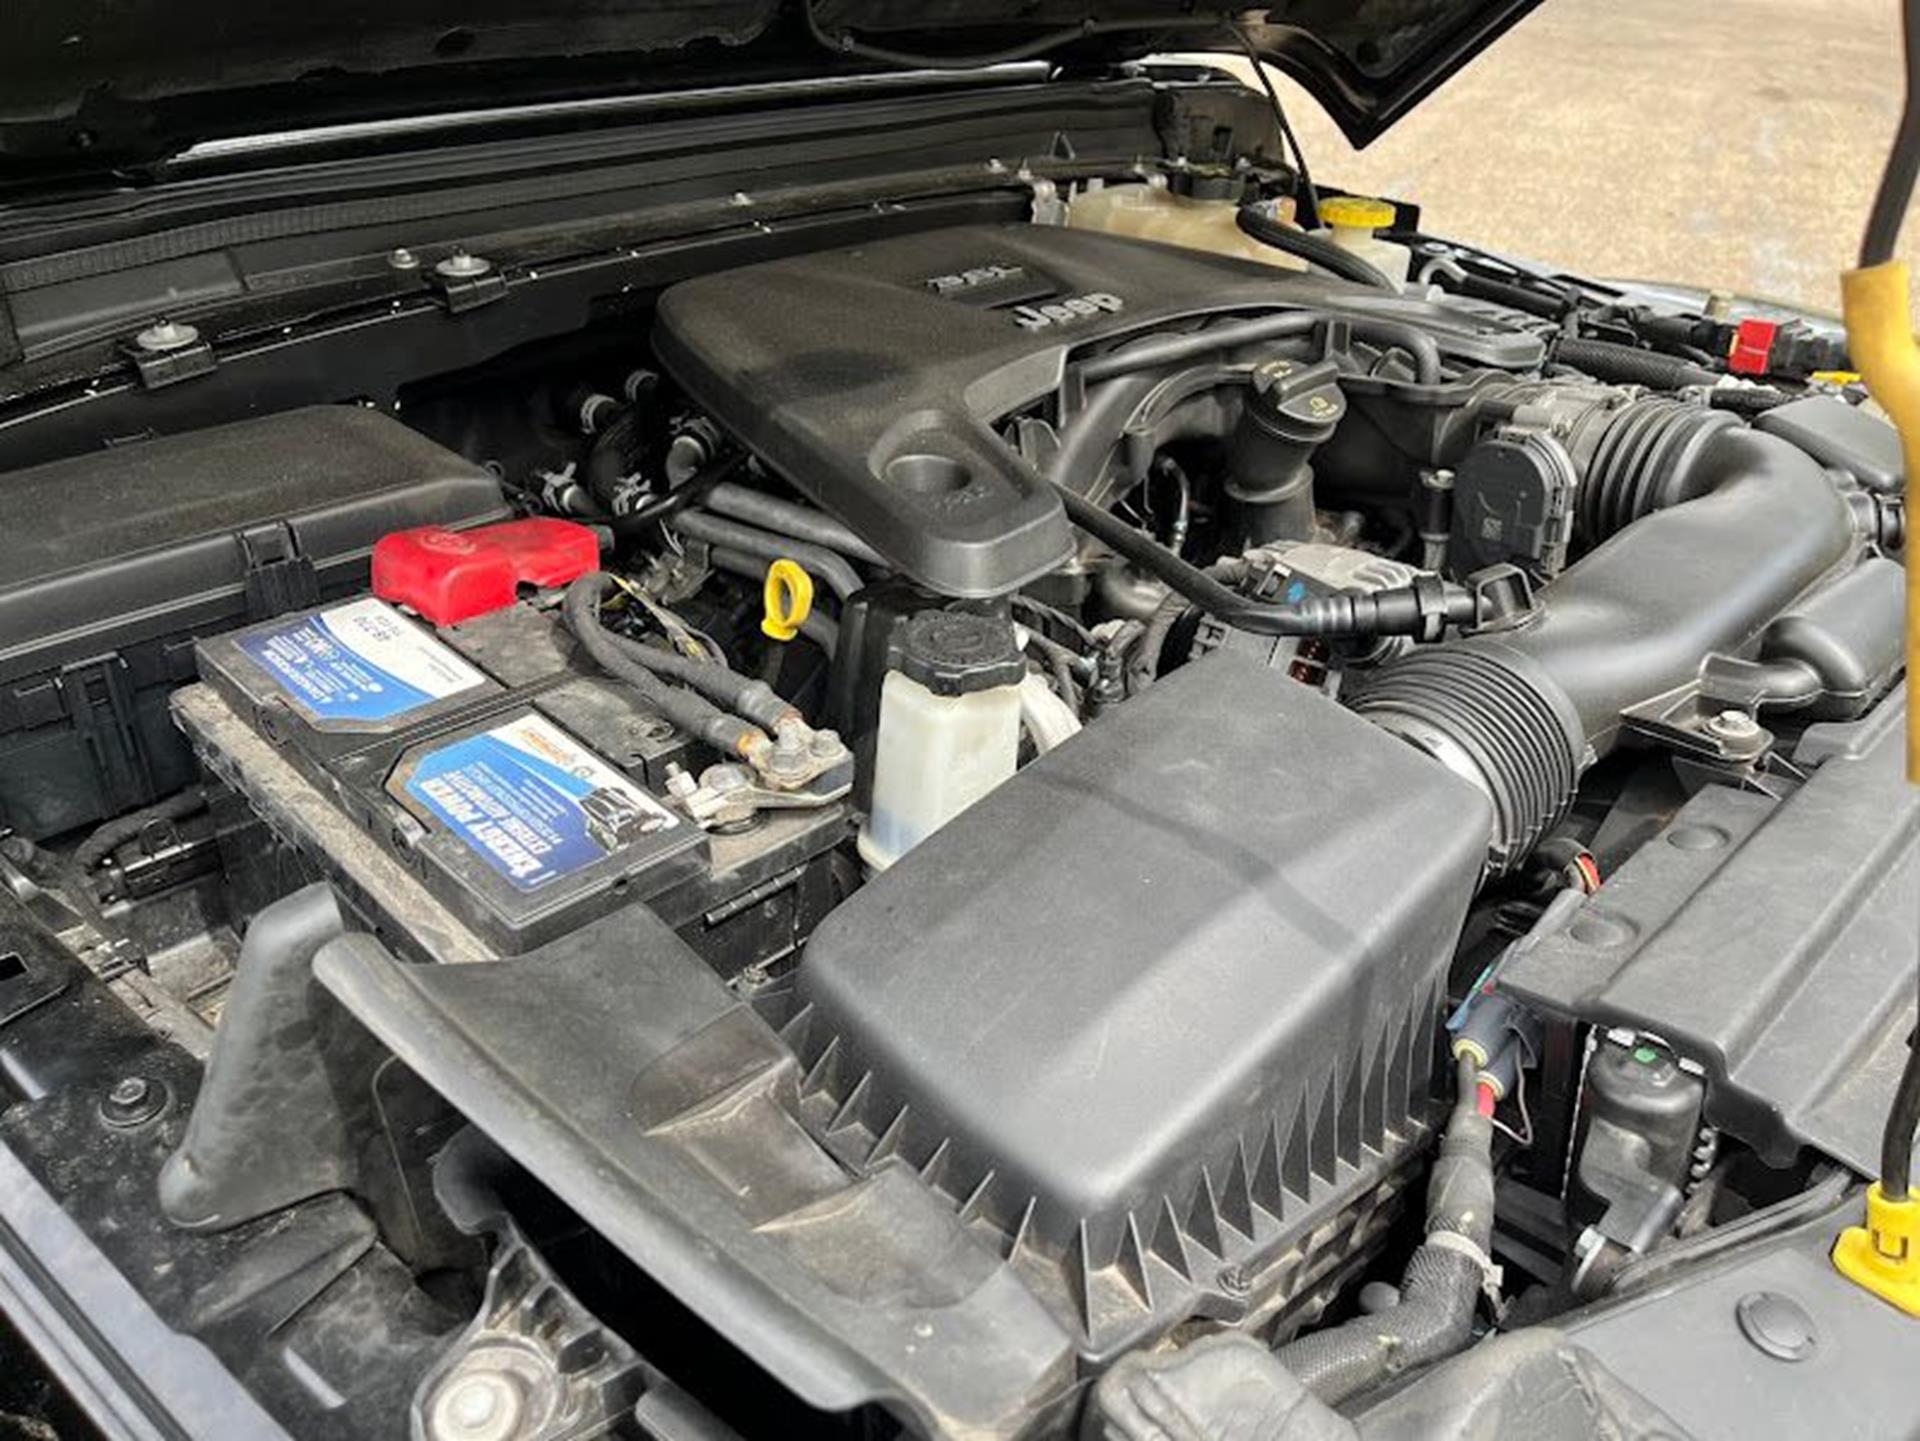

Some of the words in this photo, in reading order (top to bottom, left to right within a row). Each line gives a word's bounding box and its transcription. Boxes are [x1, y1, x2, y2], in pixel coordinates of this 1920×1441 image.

[1012, 293, 1123, 332] Jeep
[419, 776, 484, 824] POWER
[465, 819, 544, 879] ENERGY
